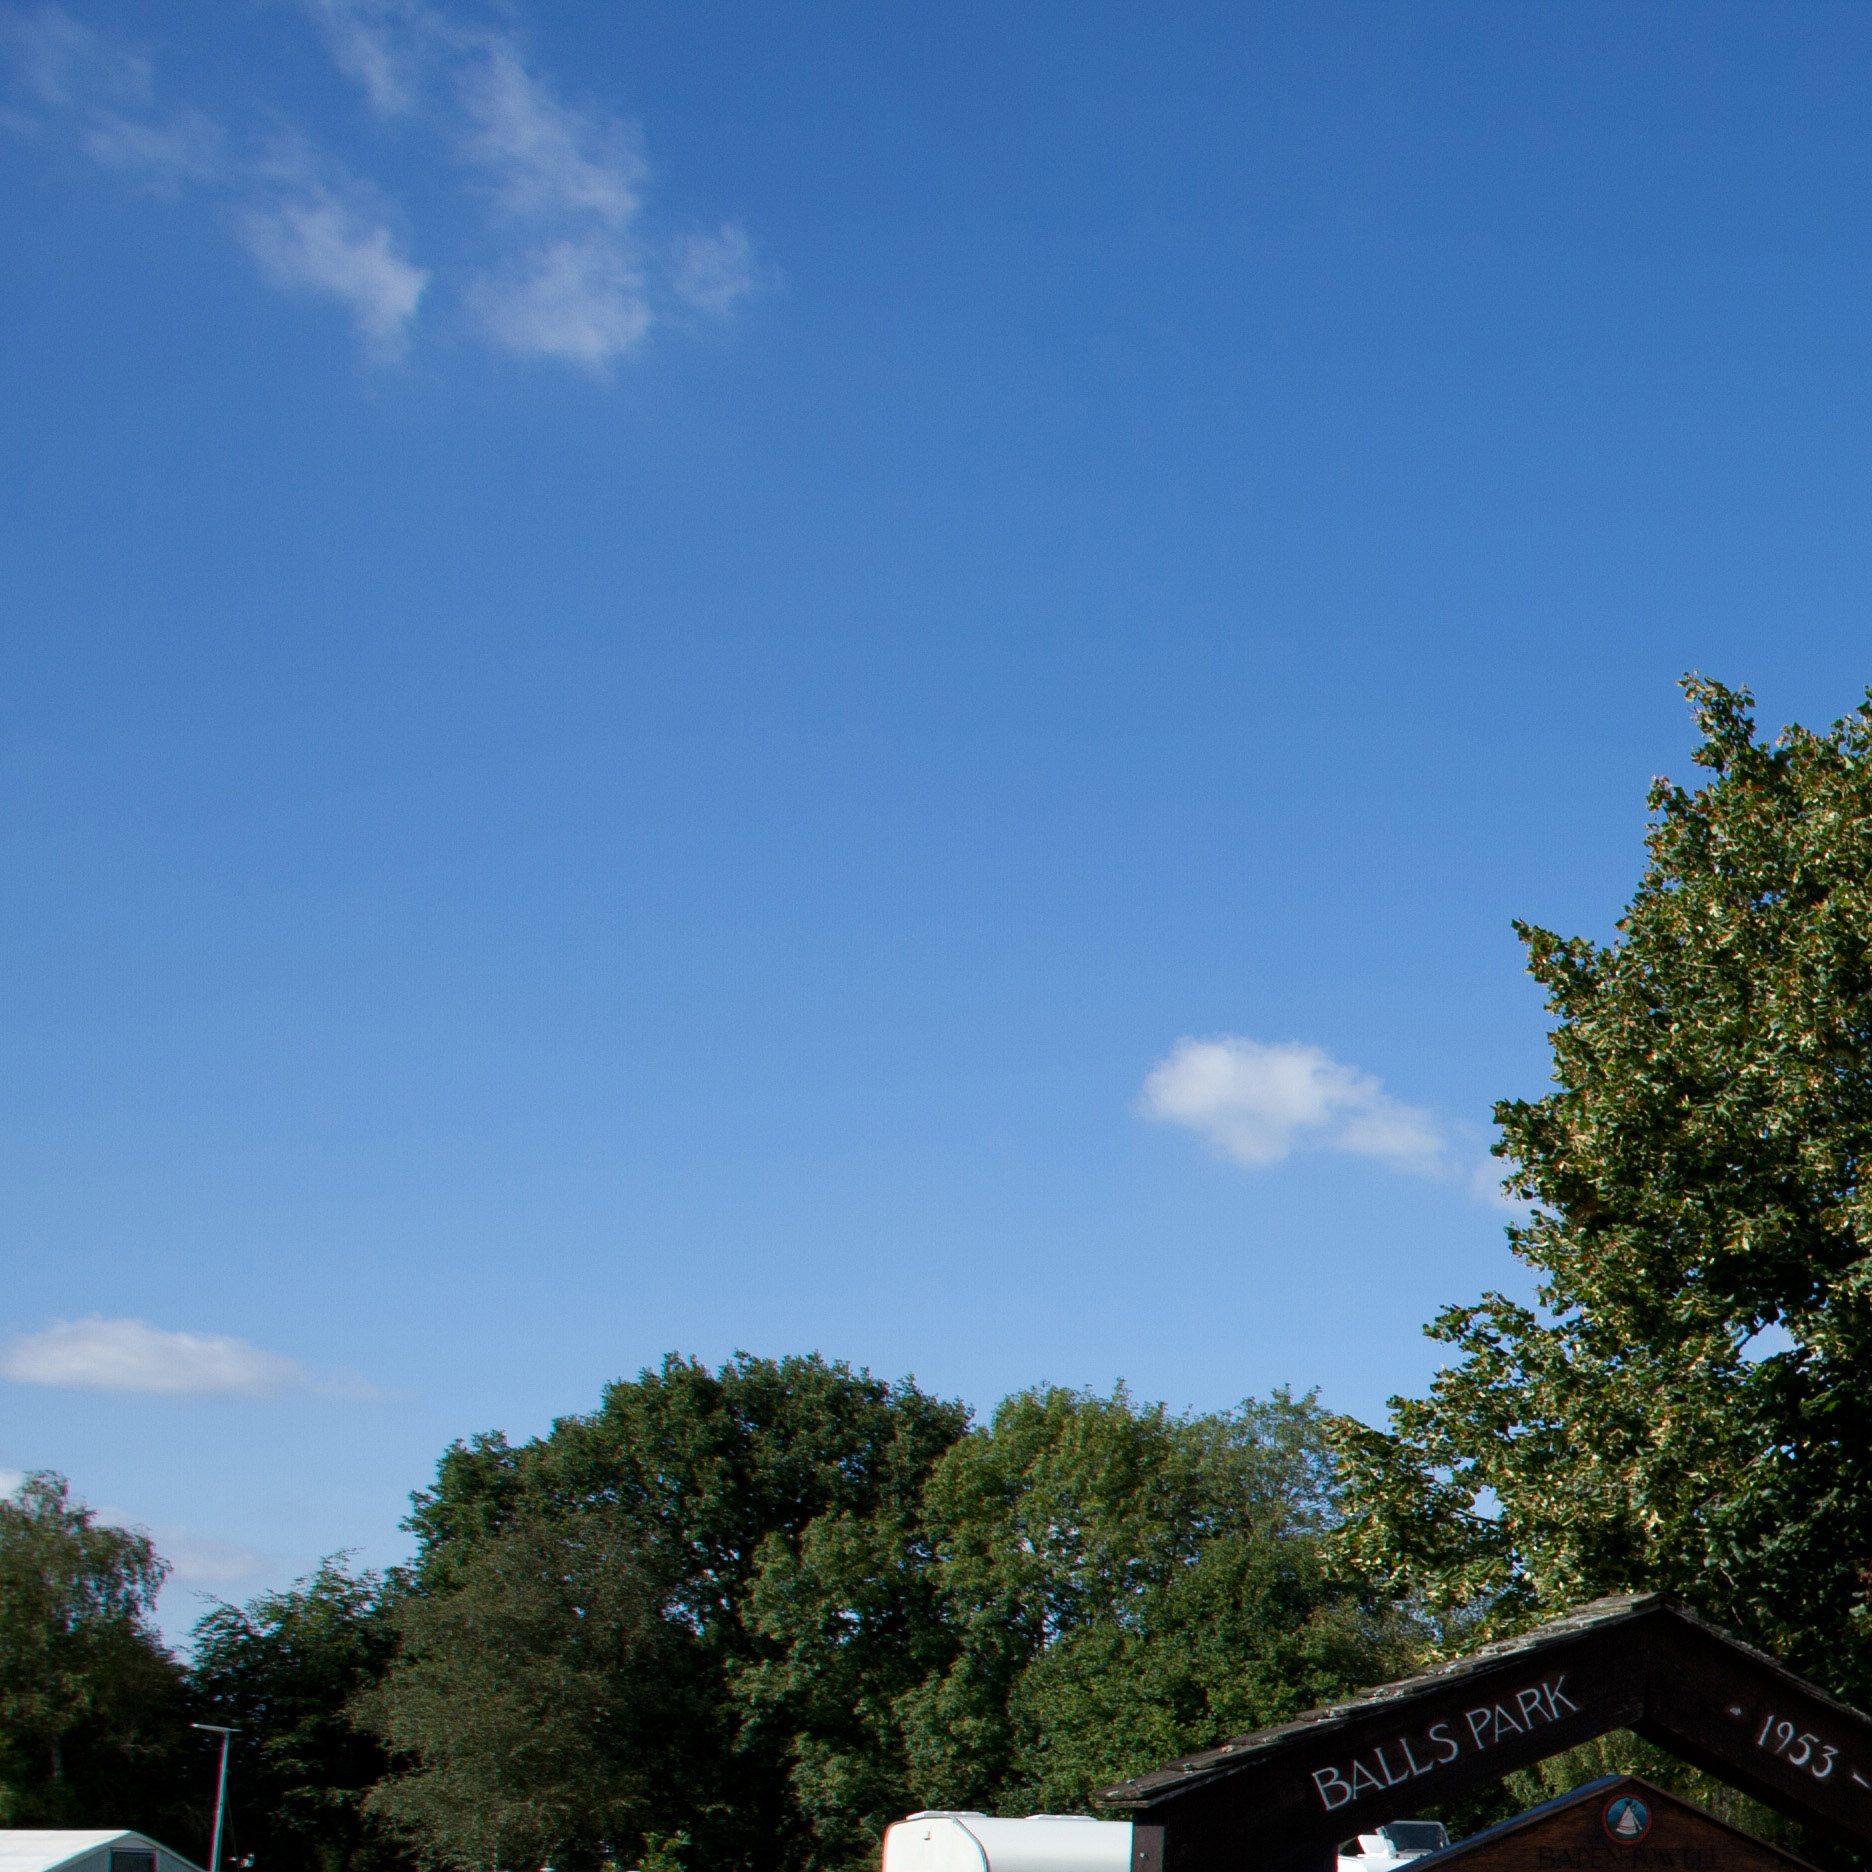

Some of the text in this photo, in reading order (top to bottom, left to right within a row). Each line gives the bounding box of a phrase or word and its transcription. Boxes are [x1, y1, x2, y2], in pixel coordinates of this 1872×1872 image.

[1311, 1674, 1580, 1811] BALLS PARK
[1757, 1714, 1839, 1778] 1953
